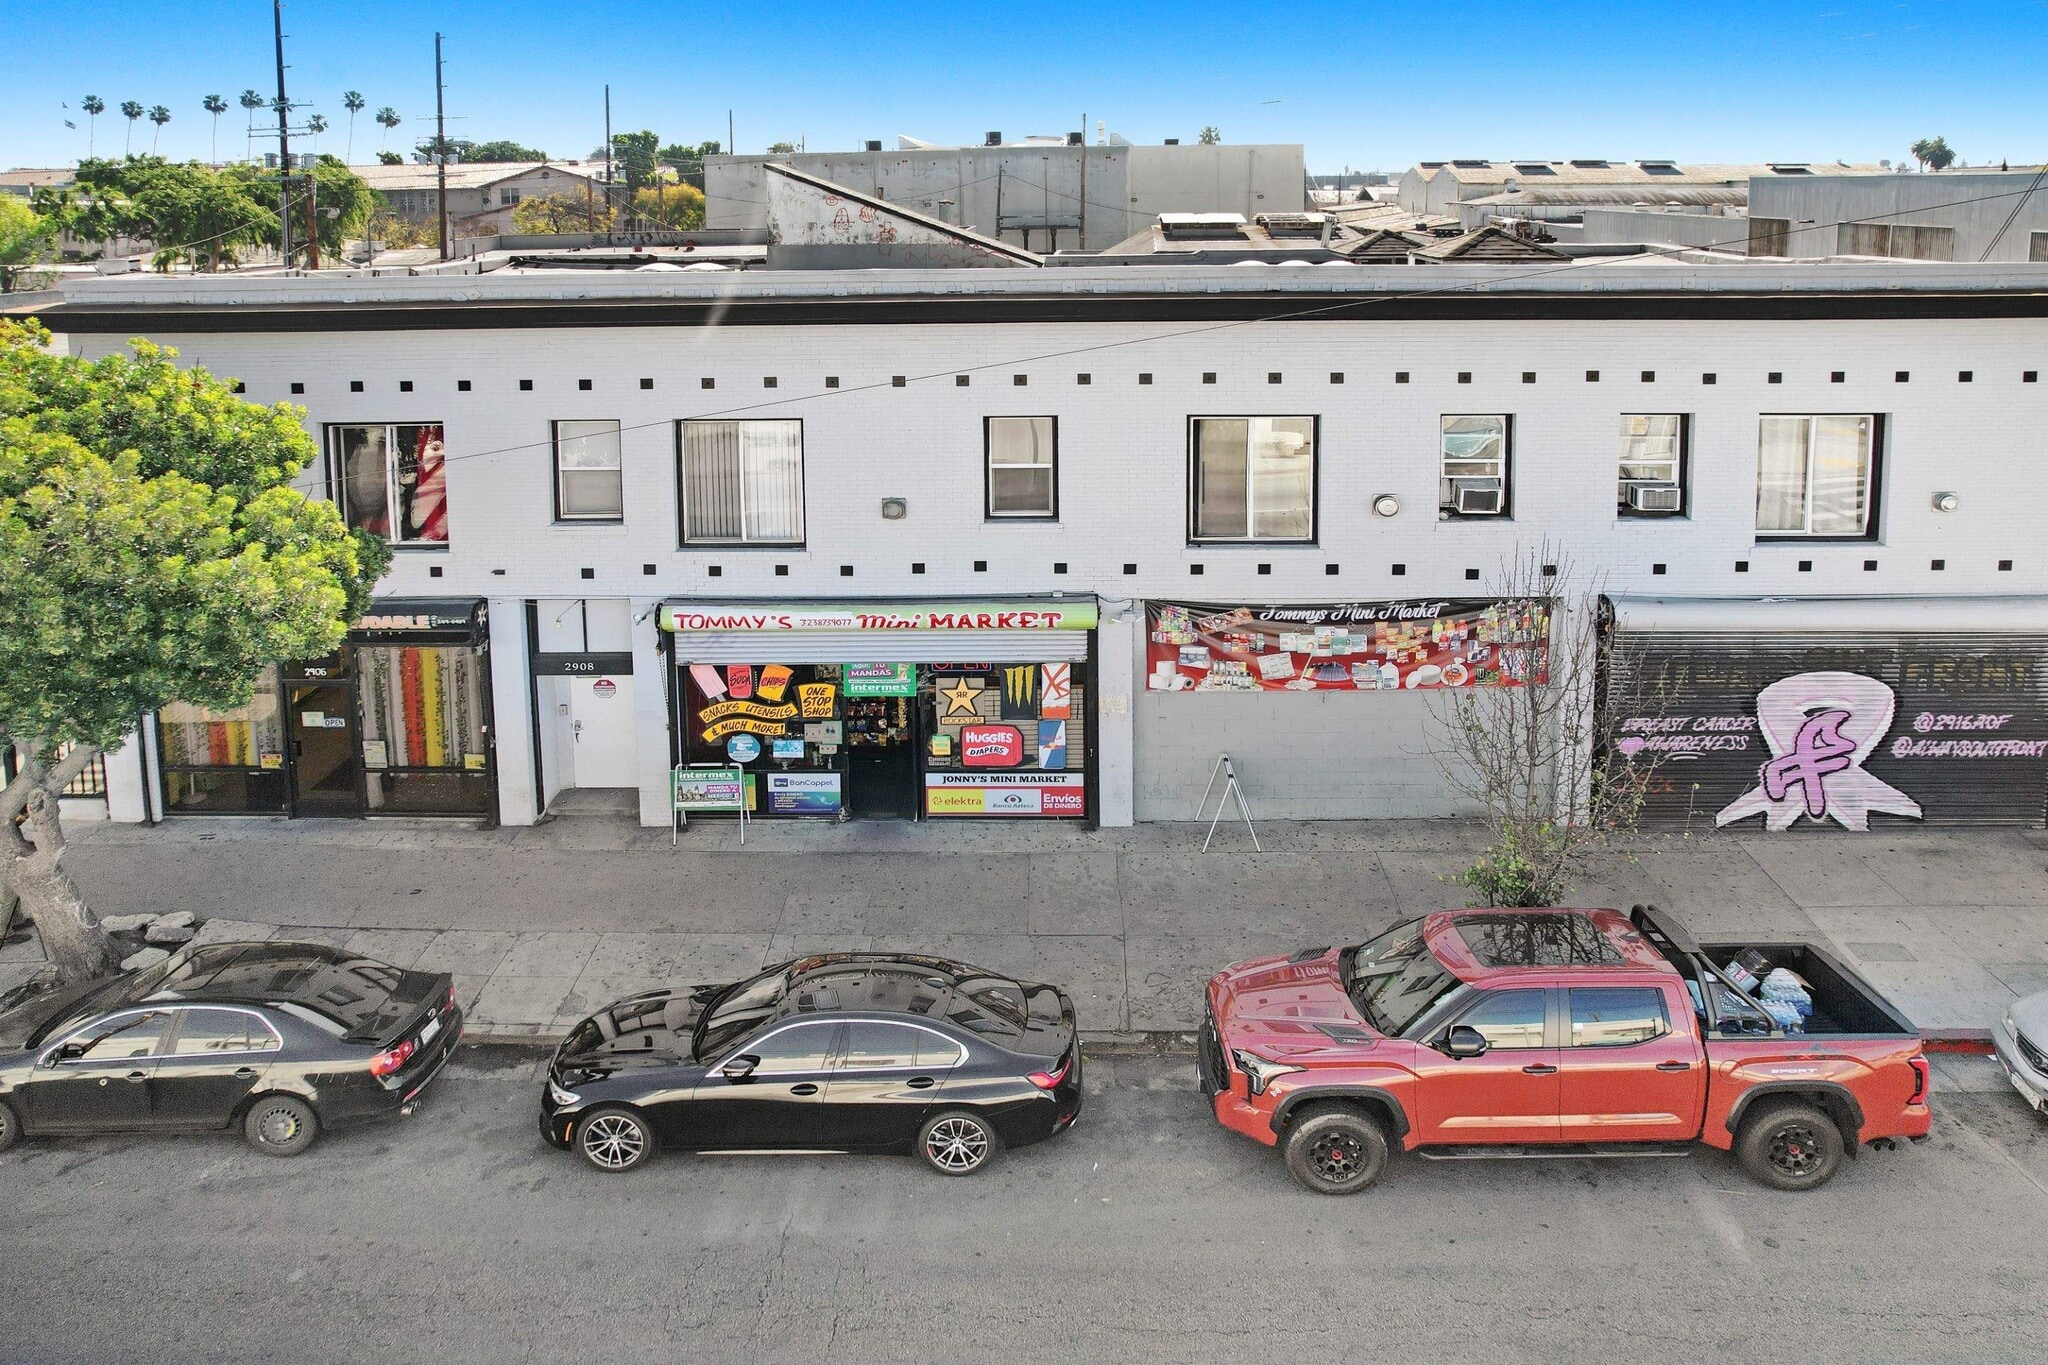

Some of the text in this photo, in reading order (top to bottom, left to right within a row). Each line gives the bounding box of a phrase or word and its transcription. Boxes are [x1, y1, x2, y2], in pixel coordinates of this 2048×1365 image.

[1260, 601, 1450, 624] Tommys Mini Market
[673, 613, 793, 629] TOMMY'S
[928, 612, 1062, 629] MARKET
[304, 667, 327, 676] 2906
[564, 662, 595, 671] 2908
[729, 673, 751, 686] SODA
[760, 676, 786, 687] CHIPS
[806, 687, 828, 696] ONE
[850, 683, 908, 691] intermex
[802, 696, 832, 707] STOP
[703, 702, 793, 723] SNACKS UTENSILS
[803, 707, 832, 716] SHOP
[721, 720, 747, 733] MUCH
[751, 722, 785, 734] MORE!
[1693, 715, 1757, 732] CANCER
[965, 731, 1013, 744] HUGGIES
[970, 747, 1005, 756] DIAPERS
[679, 771, 734, 779] intermex
[942, 775, 1068, 784] JONNY'S MINI MARKET
[789, 779, 834, 787] BanCoppel
[944, 796, 982, 806] elektra
[1043, 793, 1082, 803] Envíos
